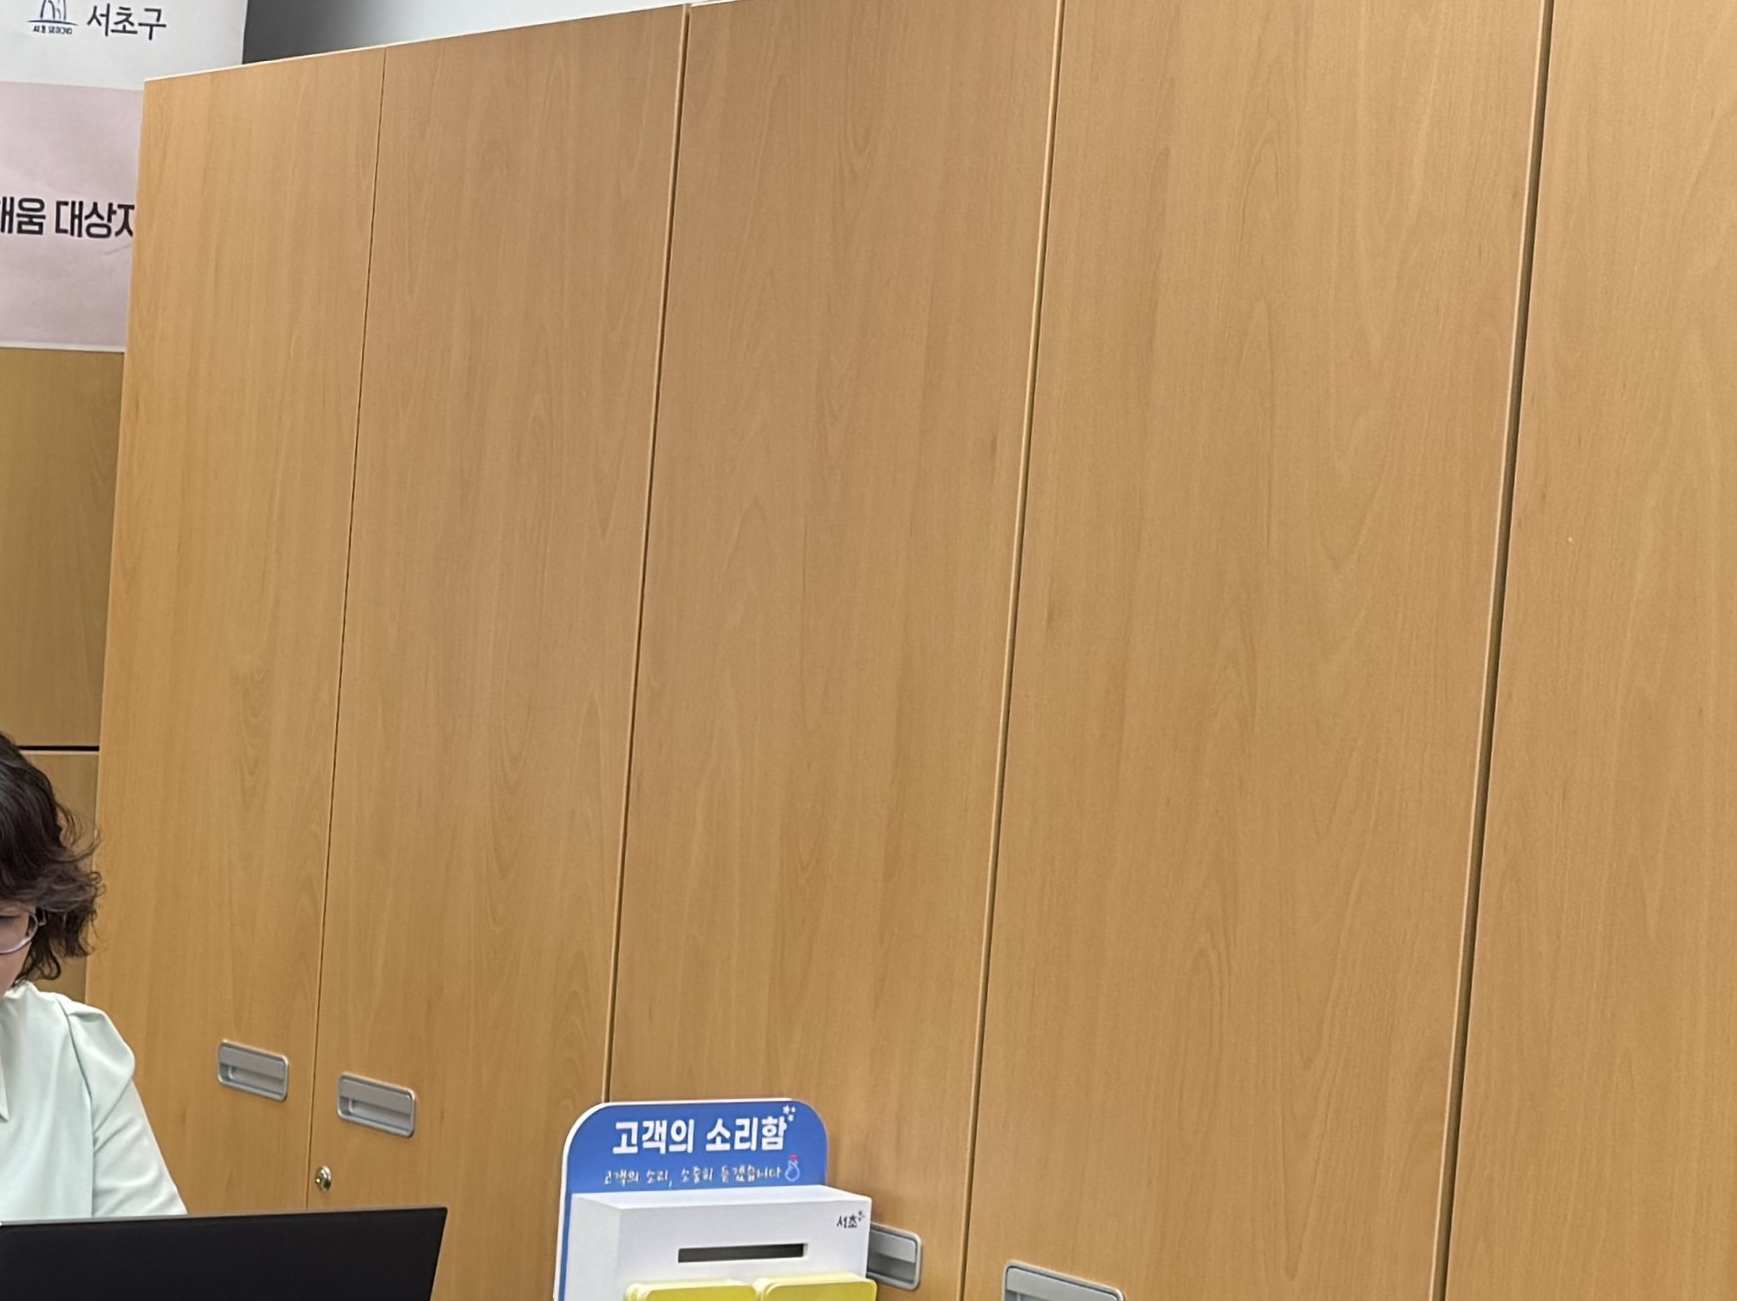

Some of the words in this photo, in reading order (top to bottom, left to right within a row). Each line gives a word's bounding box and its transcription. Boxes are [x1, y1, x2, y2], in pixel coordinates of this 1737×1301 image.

[86, 2, 168, 41] 서초구
[612, 1118, 695, 1155] 고객의
[705, 1116, 788, 1152] 소리함
